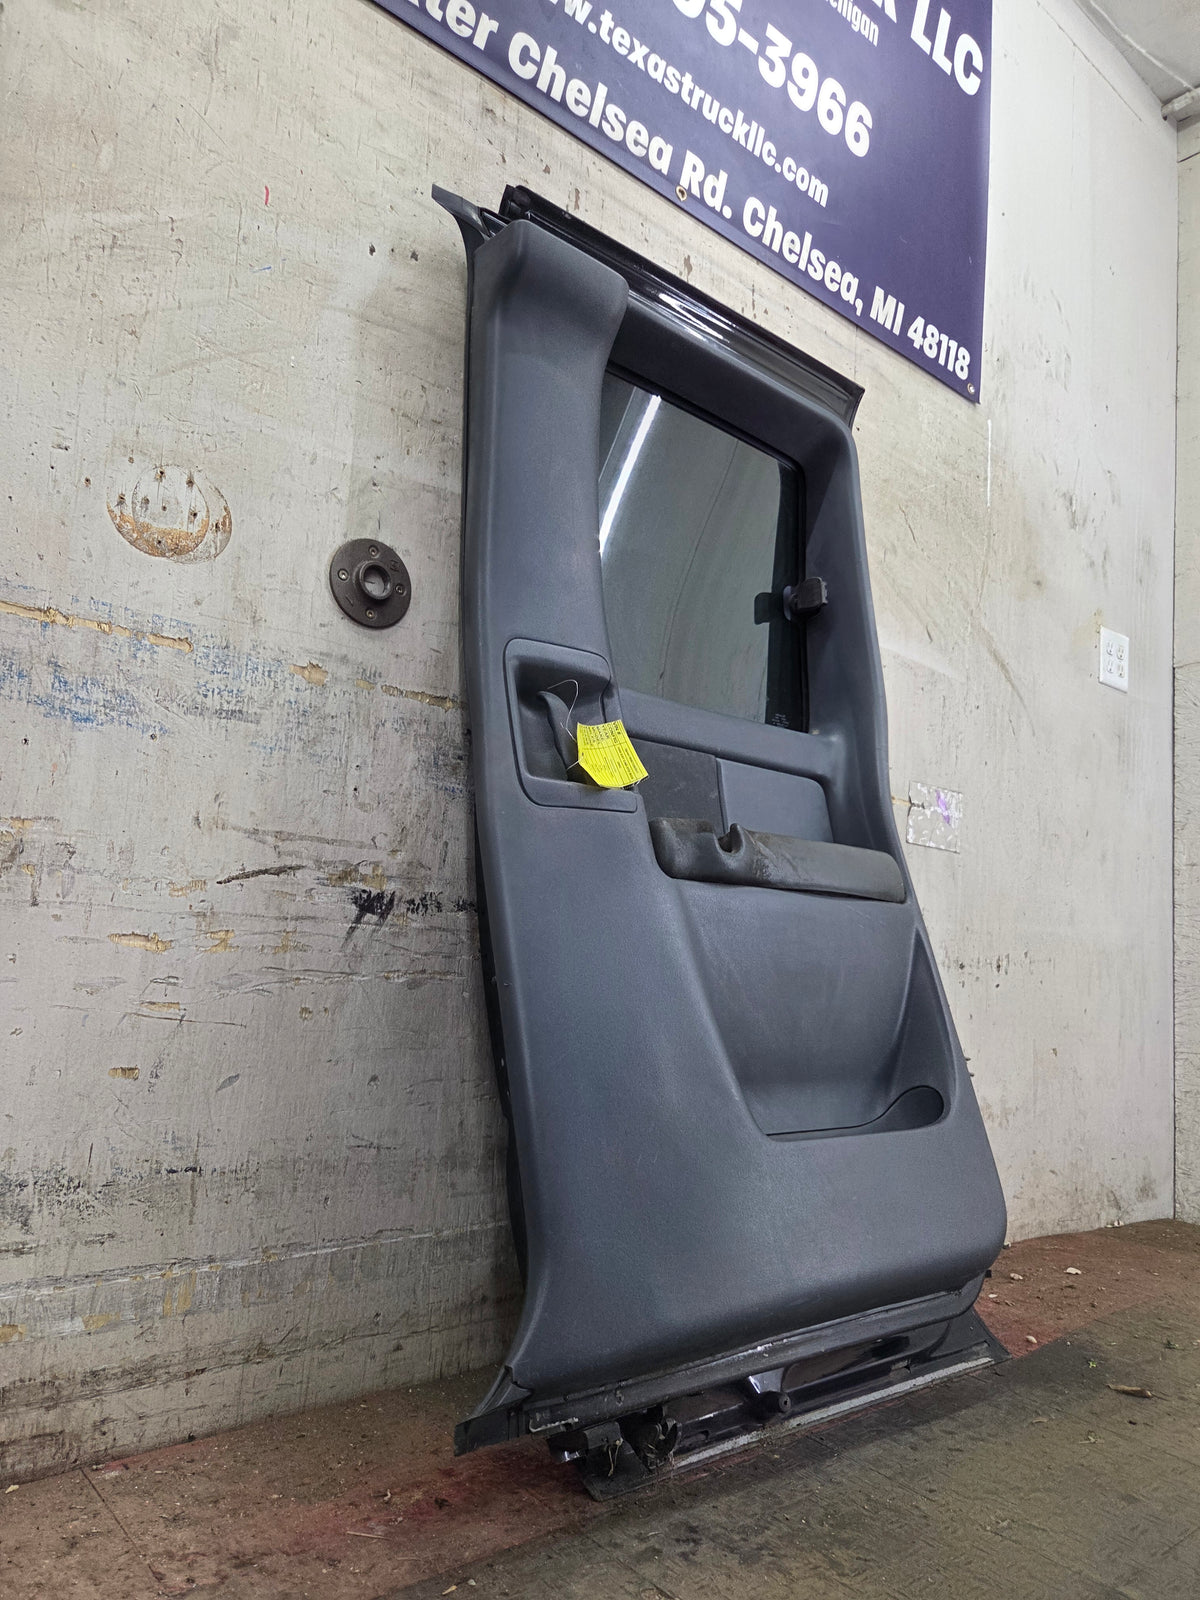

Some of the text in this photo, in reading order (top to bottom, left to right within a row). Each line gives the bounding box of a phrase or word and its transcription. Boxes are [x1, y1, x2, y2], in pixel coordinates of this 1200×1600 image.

[549, 0, 829, 208] w.texastruckllc.com
[672, 0, 873, 158] 5-3966
[911, 0, 984, 96] LLC
[407, 0, 971, 381] ter Chelsea Rd. Chelsea, MI 48118
